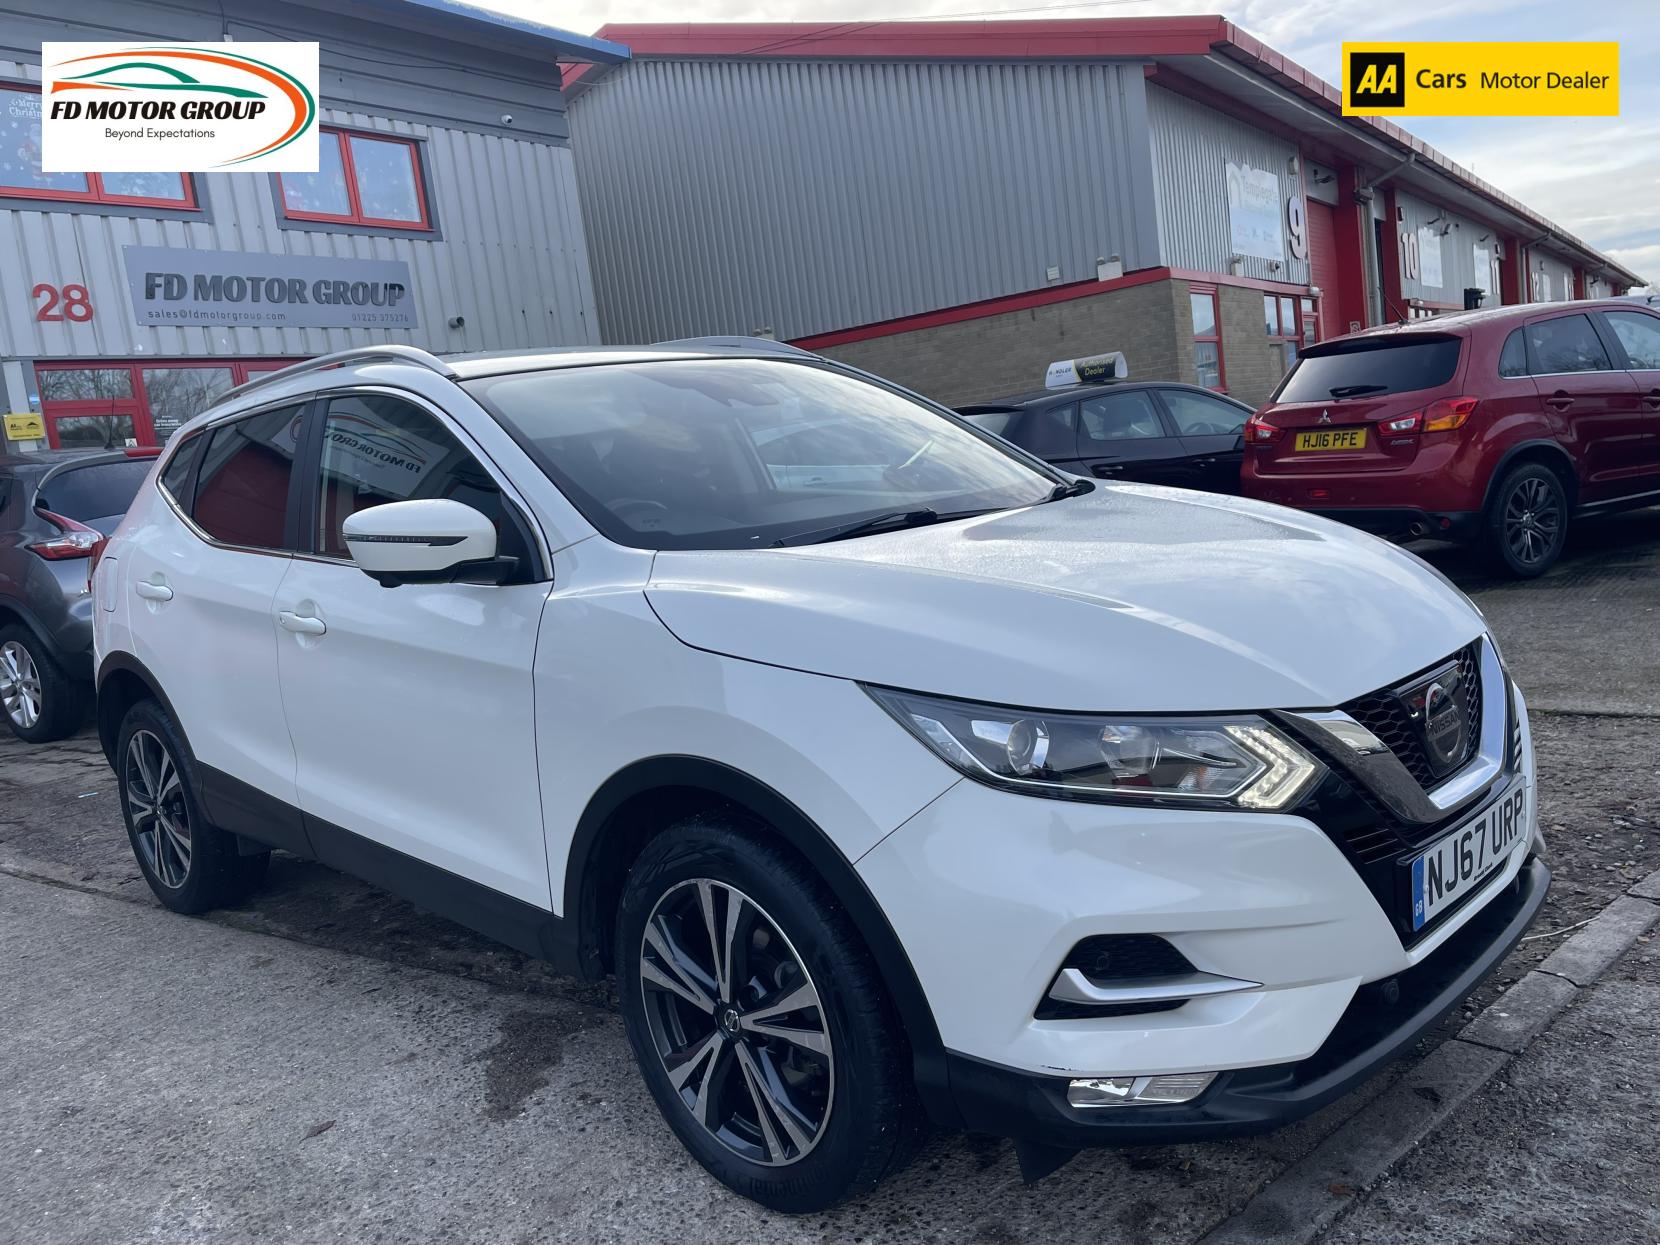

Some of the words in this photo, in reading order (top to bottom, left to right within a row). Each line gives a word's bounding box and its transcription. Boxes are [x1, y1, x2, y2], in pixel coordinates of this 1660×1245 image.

[1287, 194, 1308, 260] 9
[1401, 232, 1418, 280] 10
[32, 283, 94, 323] 28
[145, 272, 188, 300] FD
[193, 274, 309, 304] MOTOR
[312, 279, 406, 307] GROUP
[147, 309, 287, 322] sales@fdmotorgroup.com
[1084, 366, 1106, 376] Dealer
[1302, 433, 1329, 448] HJ16
[1332, 431, 1358, 447] PFE
[1428, 818, 1487, 907] NJ67
[1492, 789, 1523, 855] URP
